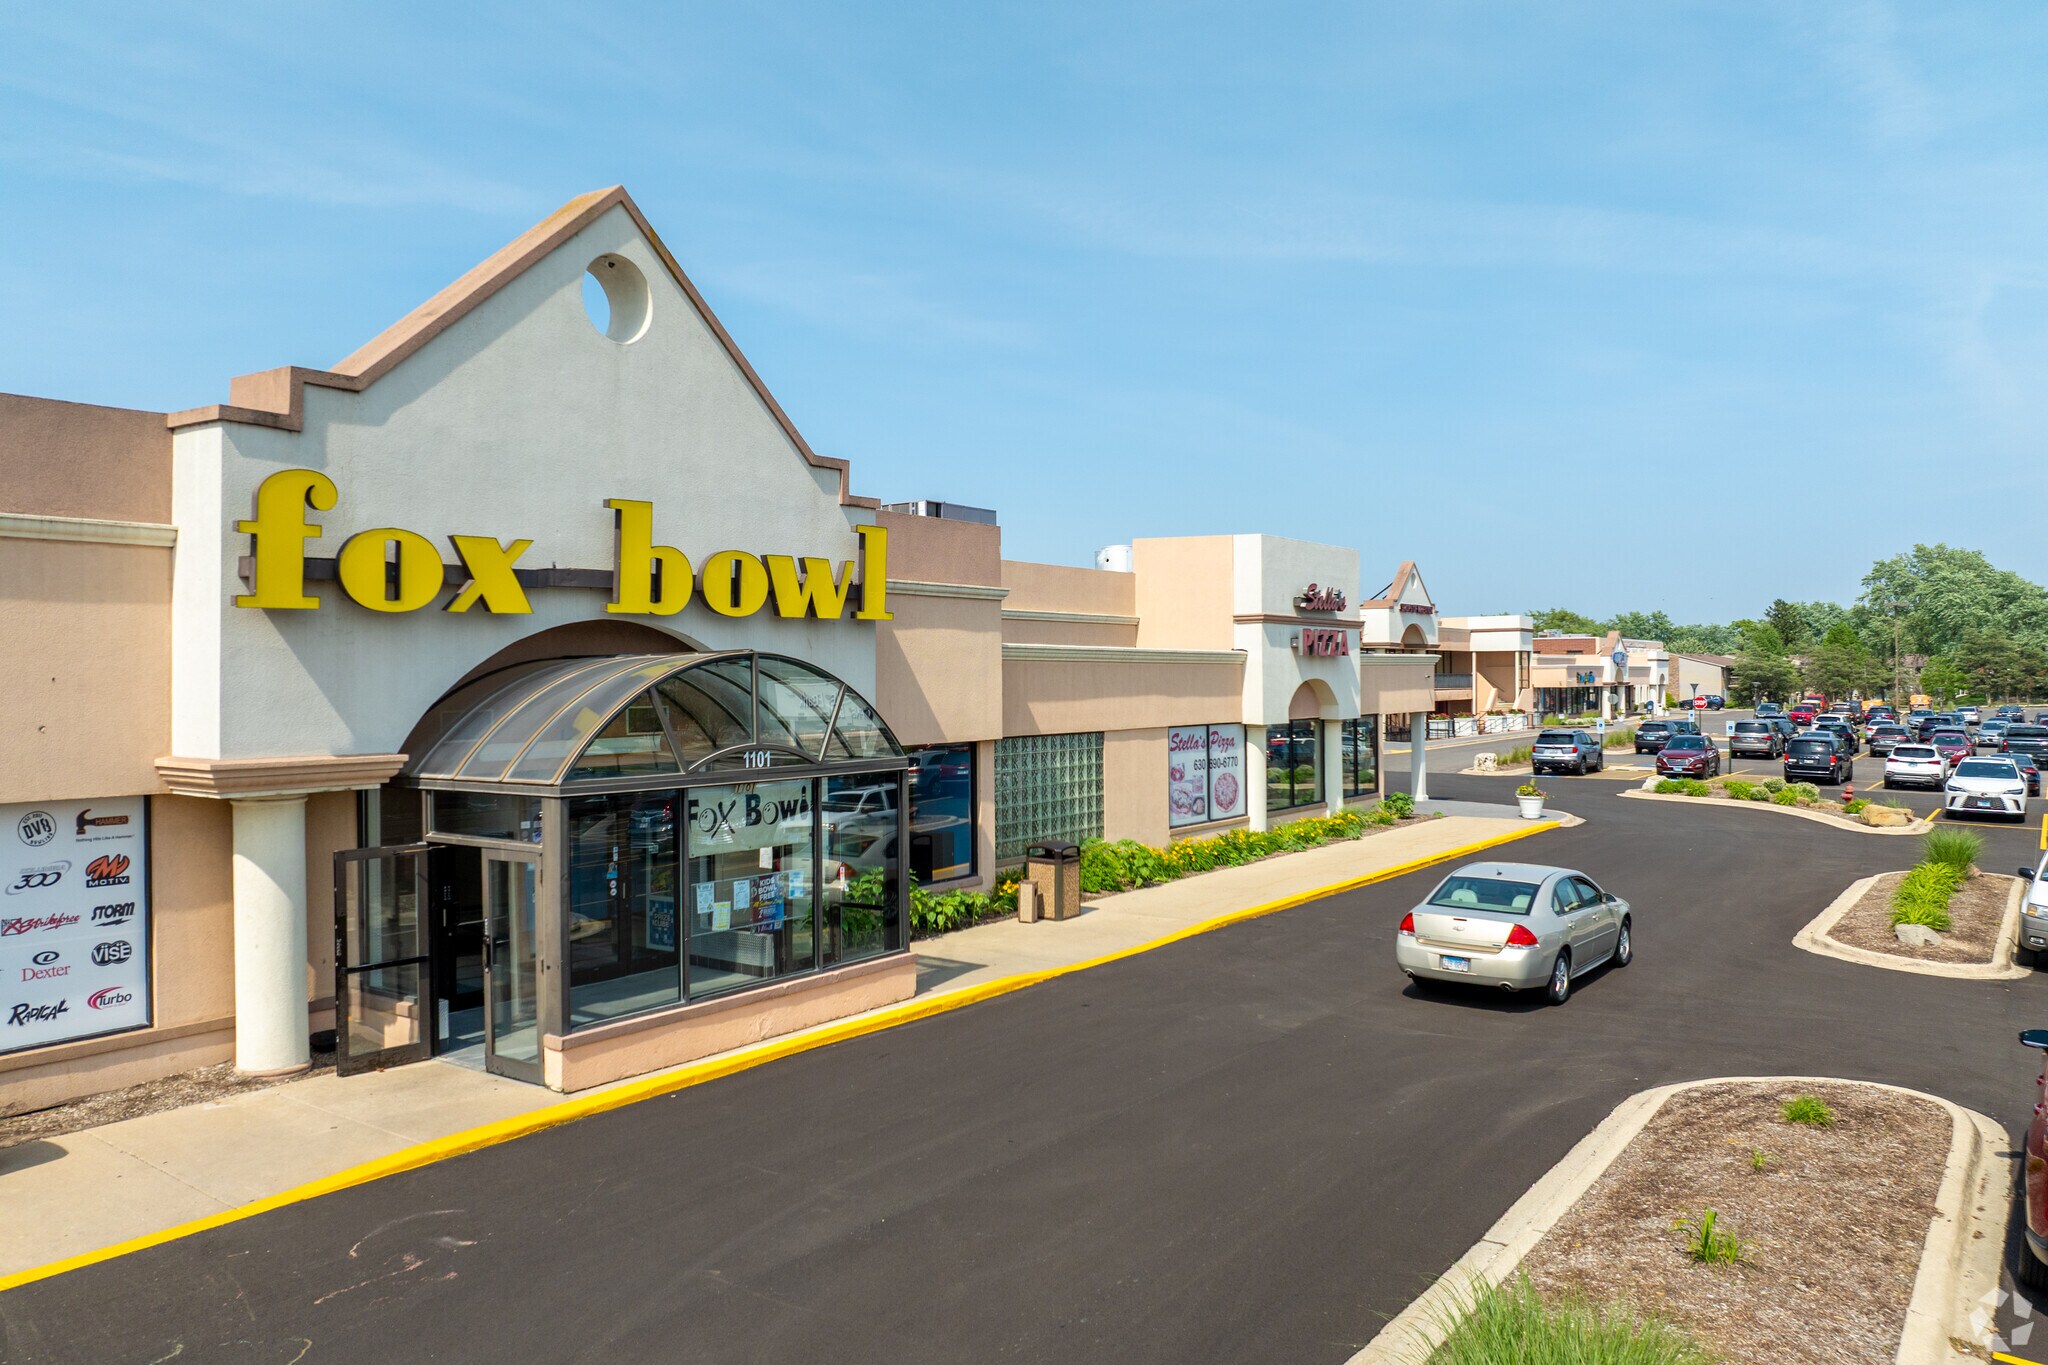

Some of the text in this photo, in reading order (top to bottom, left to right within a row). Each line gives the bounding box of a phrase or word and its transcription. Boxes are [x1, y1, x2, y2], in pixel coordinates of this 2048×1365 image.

[230, 468, 894, 620] fox bowl
[1302, 628, 1350, 656] PIZZA
[1169, 730, 1236, 753] Stella's Pizza
[743, 750, 771, 769] 1101
[1193, 758, 1207, 771] 630
[22, 817, 52, 839] DV8
[95, 815, 128, 826] HAMMER
[14, 871, 62, 890] 300
[88, 877, 127, 887] MOTIV
[758, 883, 778, 895] BOWL
[760, 890, 776, 901] FREE
[91, 902, 135, 921] STORM
[21, 966, 70, 982] Dexter
[98, 993, 132, 1006] Turbo
